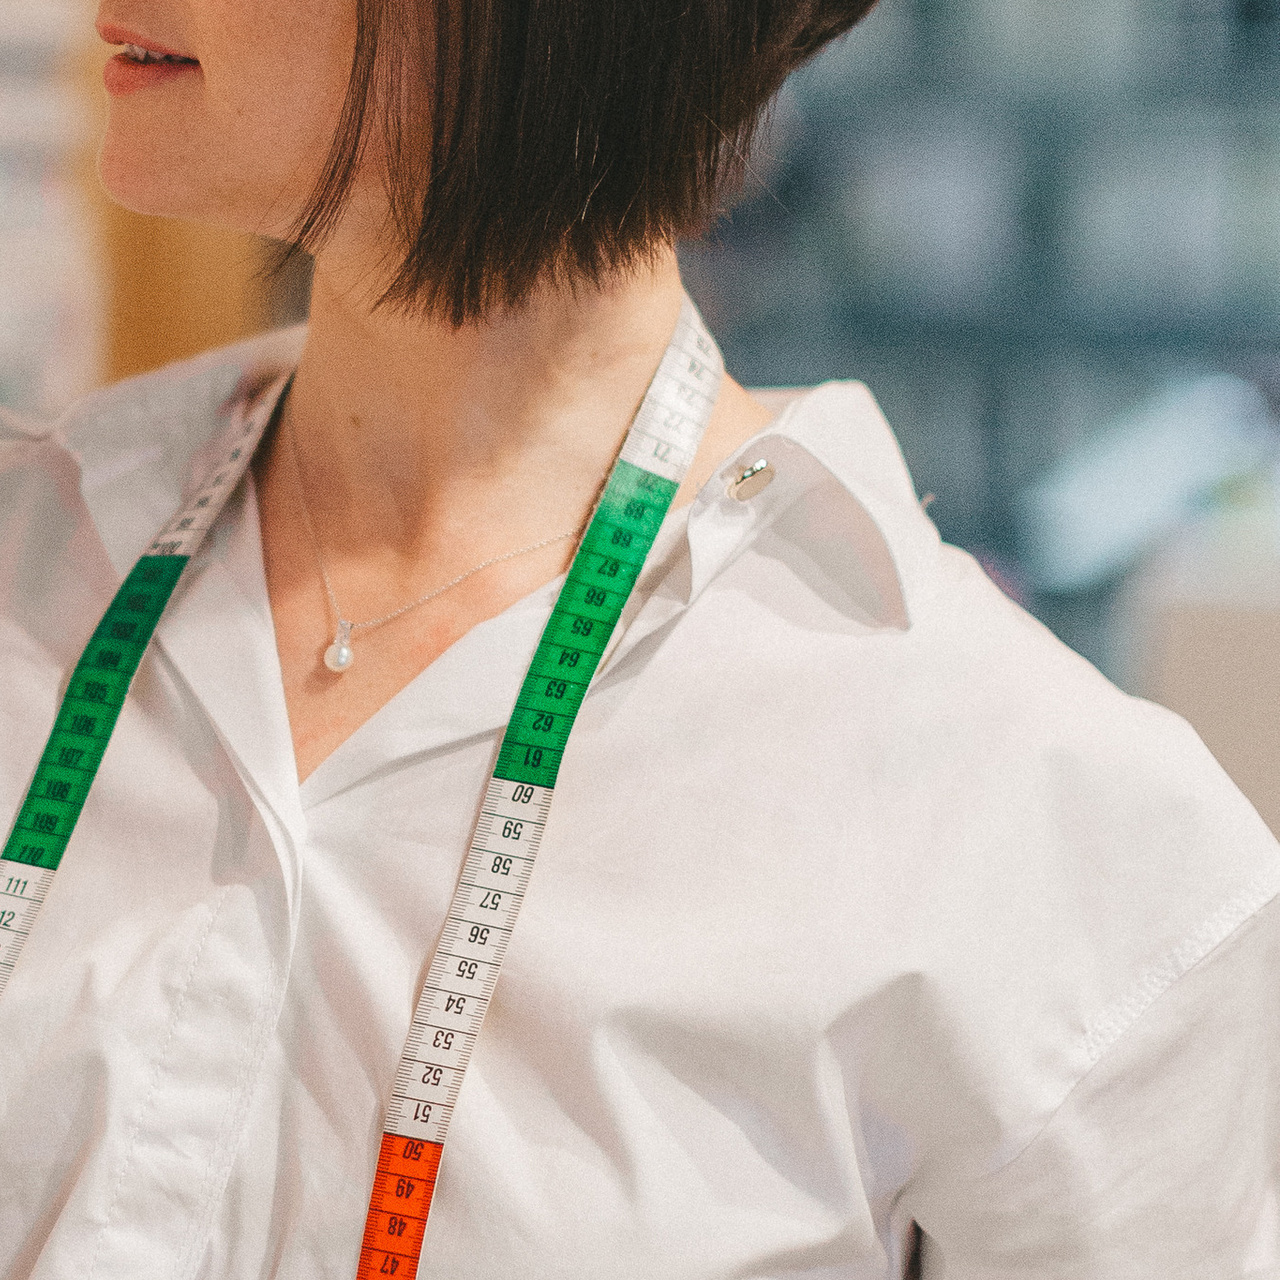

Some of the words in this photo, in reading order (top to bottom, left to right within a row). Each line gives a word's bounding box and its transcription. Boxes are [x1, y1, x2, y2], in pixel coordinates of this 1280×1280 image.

[653, 441, 671, 463] 71
[611, 526, 633, 548] 68
[598, 559, 620, 578] 67
[584, 586, 606, 607] 66
[571, 615, 594, 637] 65
[558, 648, 581, 668] 64
[545, 680, 567, 699] 63
[532, 713, 554, 732] 62
[57, 747, 86, 767] 107
[523, 747, 543, 768] 61
[511, 784, 535, 804] 60
[32, 812, 59, 833] 109
[502, 820, 524, 840] 59
[19, 845, 46, 866] 110
[491, 856, 513, 876] 58
[5, 876, 28, 895] 111
[479, 891, 502, 911] 57
[468, 925, 490, 945] 56
[456, 960, 478, 980] 55
[444, 994, 466, 1015] 54
[432, 1030, 455, 1050] 53
[421, 1065, 443, 1086] 52
[413, 1103, 432, 1123] 51
[402, 1140, 425, 1161] 50
[395, 1178, 415, 1199] 49
[387, 1216, 407, 1237] 48
[380, 1254, 399, 1275] 47
